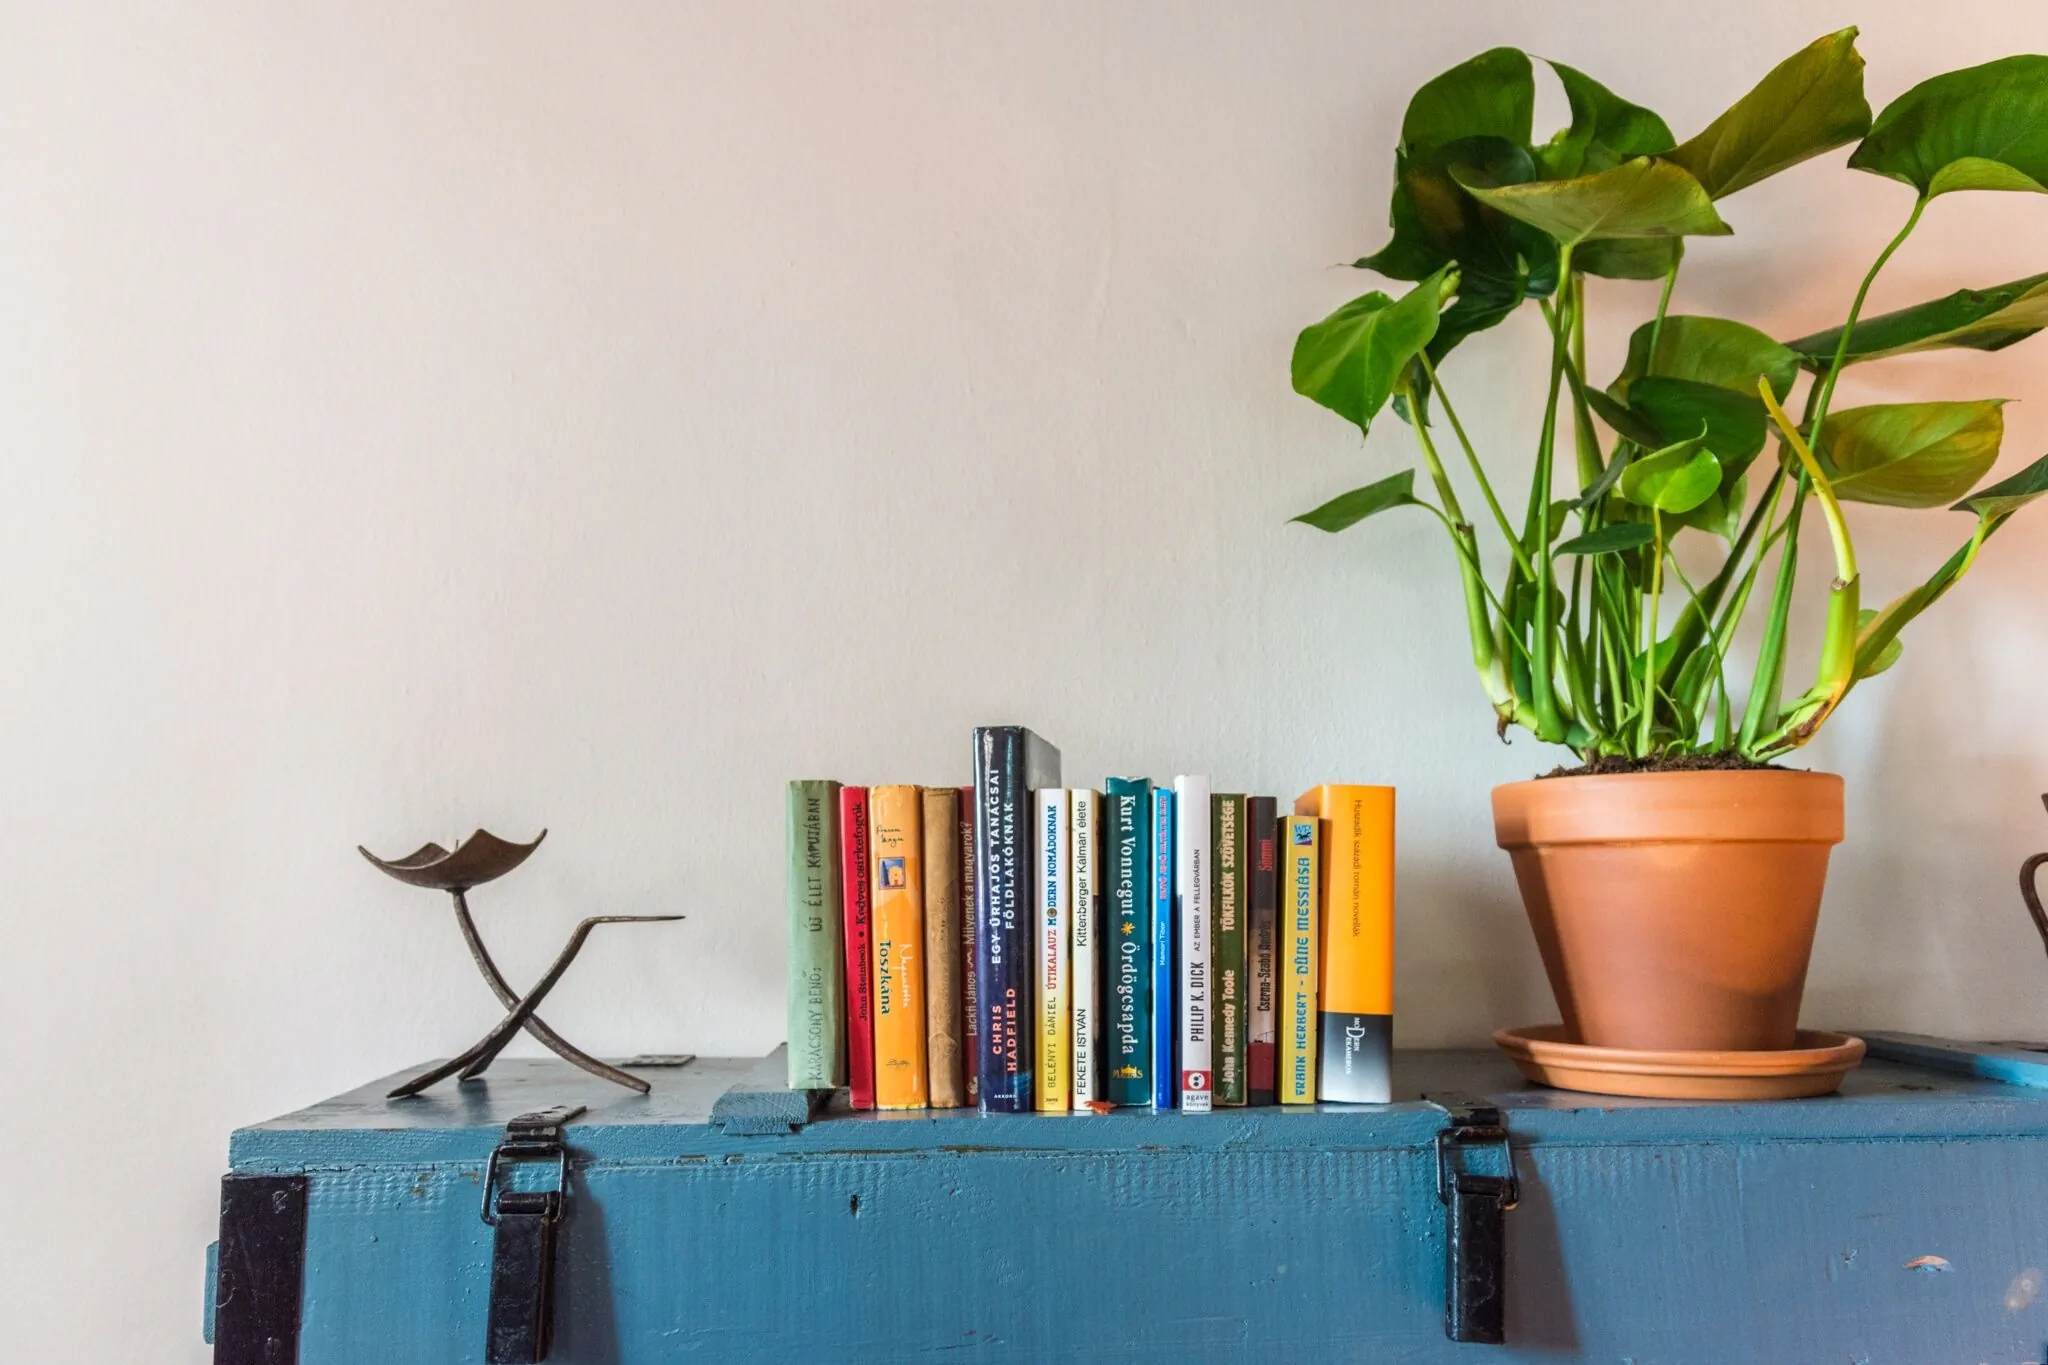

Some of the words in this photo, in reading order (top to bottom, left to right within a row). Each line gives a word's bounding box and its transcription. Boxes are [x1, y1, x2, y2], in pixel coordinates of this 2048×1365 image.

[985, 769, 1000, 847] TANÁCSAI
[1076, 800, 1087, 828] élete
[1120, 795, 1136, 832] Kurt
[1354, 799, 1362, 838] Huszadik
[804, 798, 821, 868] KAPUJÁBAN
[852, 803, 865, 878] csirkefogók
[960, 822, 975, 881] magyarok?
[1045, 805, 1057, 877] NOMÁDOKNAK
[1076, 831, 1087, 876] Kálmán
[804, 877, 822, 907] ÉLET
[1116, 836, 1136, 916] Vonnegut
[803, 916, 823, 932] ÚJ
[856, 881, 865, 925] Kedves
[962, 891, 976, 945] Milyenek
[1077, 878, 1089, 947] Kittenberger
[991, 933, 1001, 964] EGY
[1045, 929, 1057, 989] ÚTIKALAUZ
[1193, 940, 1201, 951] AZ
[857, 943, 867, 995] Steinbeck
[879, 940, 893, 1015] Toszkána
[965, 971, 977, 1003] János
[1190, 962, 1204, 988] DICK
[1222, 969, 1235, 1000] Toole
[1257, 952, 1271, 1012] Cserna-Szabó
[859, 1000, 868, 1023] John
[1116, 942, 1140, 1054] Ördögcsapda
[1190, 991, 1204, 1001] K.
[966, 1005, 977, 1037] Lackfi
[992, 1004, 1002, 1055] CHRIS
[1006, 988, 1017, 1071] HADFIELD
[1075, 1008, 1087, 1048] ISTVÁN
[1190, 1006, 1204, 1041] PHILIP
[1222, 1003, 1236, 1053] Kennedy
[1296, 992, 1307, 1050] HERBERT
[1077, 1051, 1087, 1095] FEKETE
[1222, 1056, 1235, 1083] John
[1295, 1056, 1306, 1096] FRANK
[1186, 1094, 1209, 1102] agave
